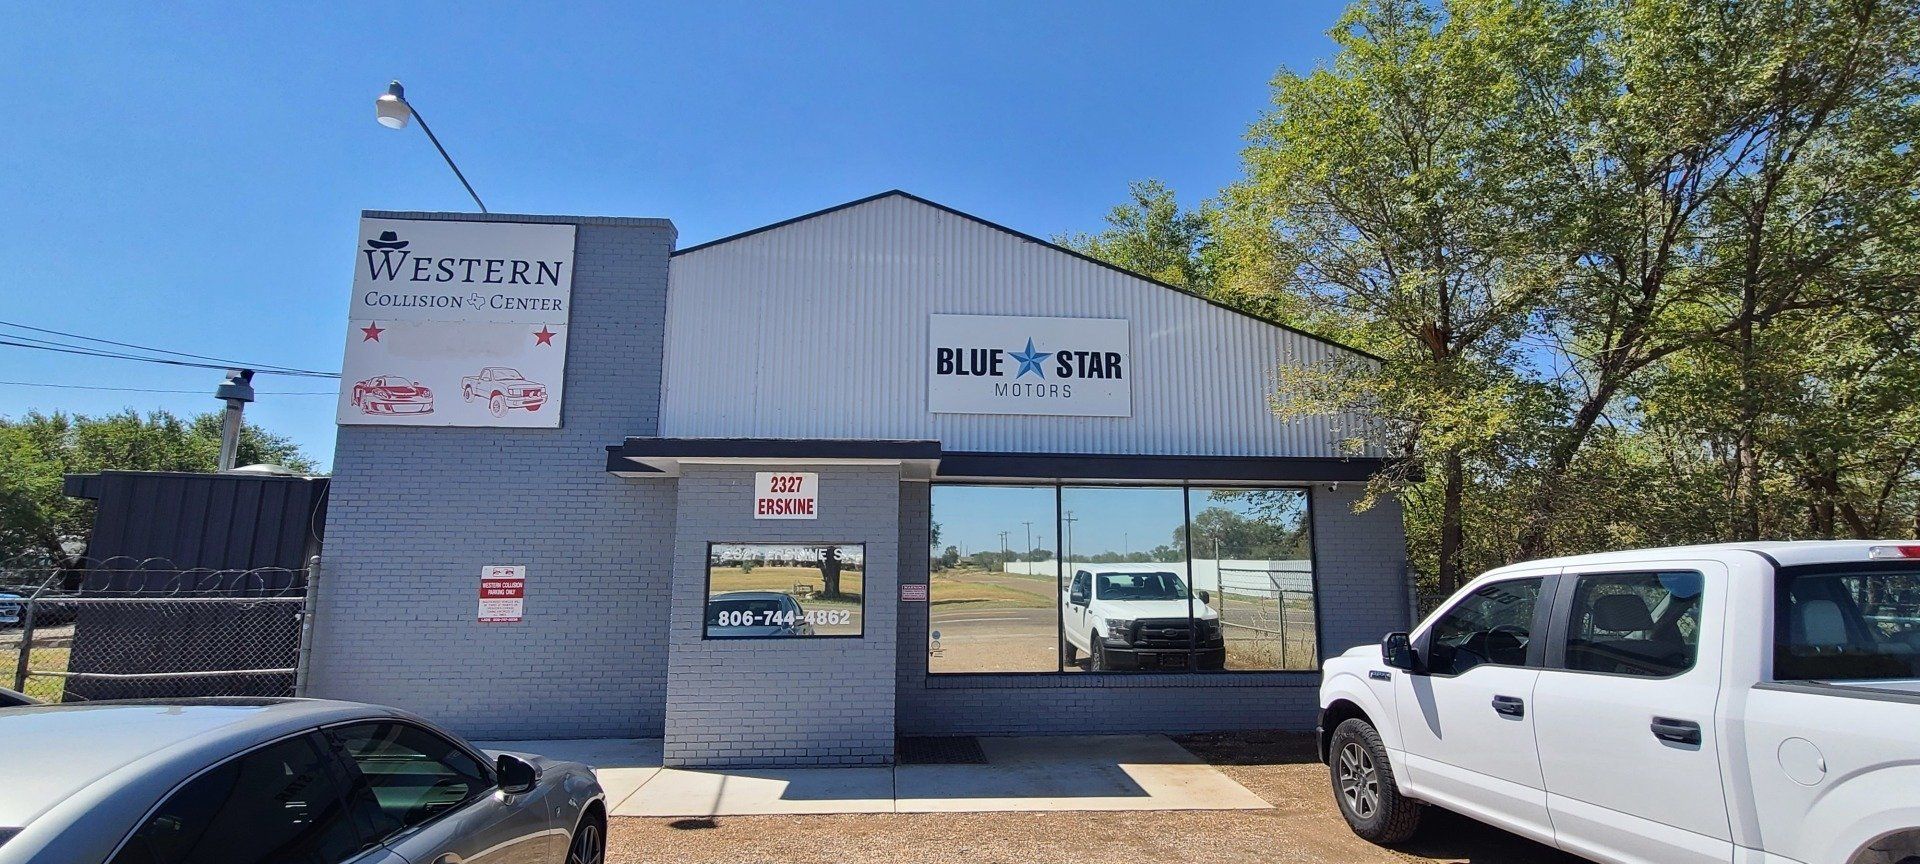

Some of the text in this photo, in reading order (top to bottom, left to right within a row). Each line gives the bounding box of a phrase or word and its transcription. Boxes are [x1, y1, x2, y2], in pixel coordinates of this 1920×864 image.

[363, 249, 563, 286] WESTERN
[364, 291, 563, 311] COLLISION CENTER
[936, 347, 1122, 379] BLUE STAR
[995, 382, 1072, 398] MOTORS
[770, 476, 803, 493] 2327
[758, 498, 814, 515] ERSKINE
[718, 610, 850, 626] 806-744-4862
